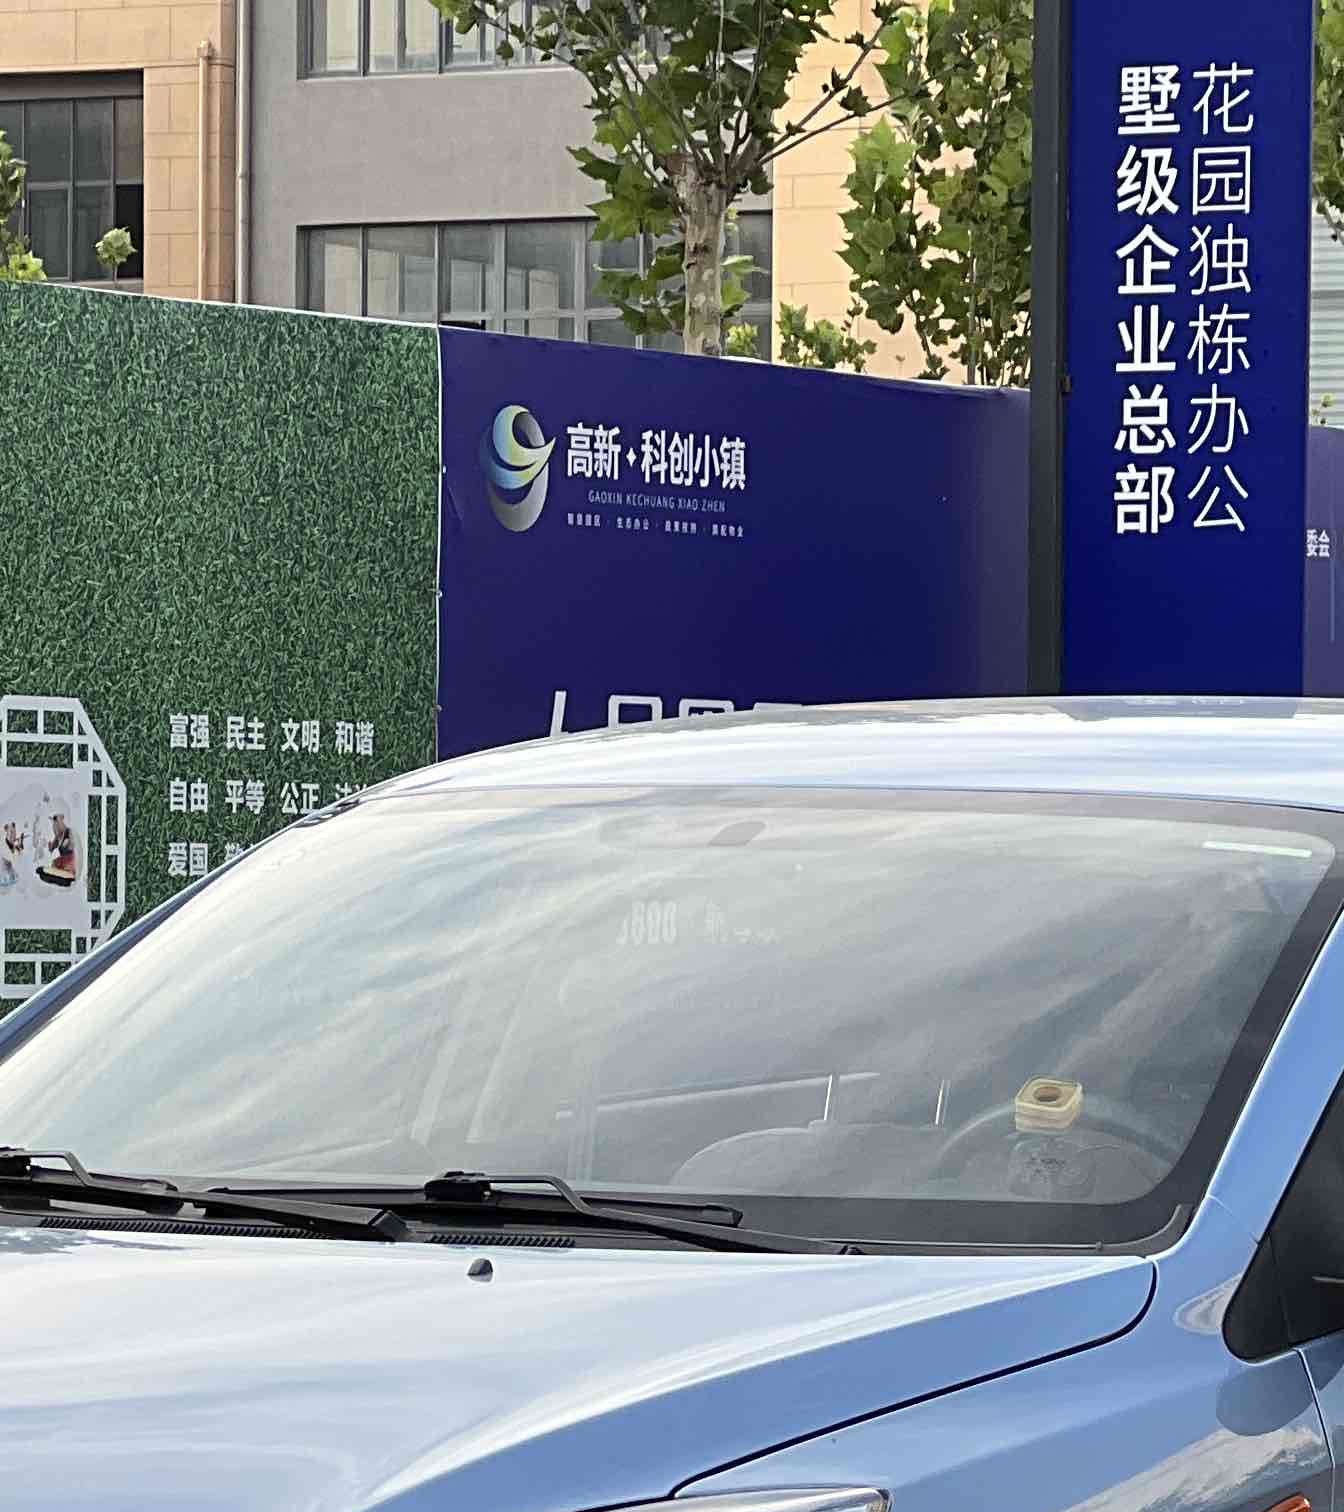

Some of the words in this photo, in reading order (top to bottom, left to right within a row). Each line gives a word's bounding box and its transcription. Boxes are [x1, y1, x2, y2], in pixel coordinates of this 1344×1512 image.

[1113, 64, 1181, 534] 墅级企业总部
[1187, 62, 1255, 533] 花园独栋办公
[169, 713, 210, 749] 富强
[226, 715, 266, 751] 民主
[280, 718, 321, 753] 文明
[335, 720, 375, 757] 和谐
[169, 777, 209, 813] 自由
[224, 779, 266, 815] 平等
[280, 782, 321, 815] 公正
[167, 841, 209, 877] 爱国
